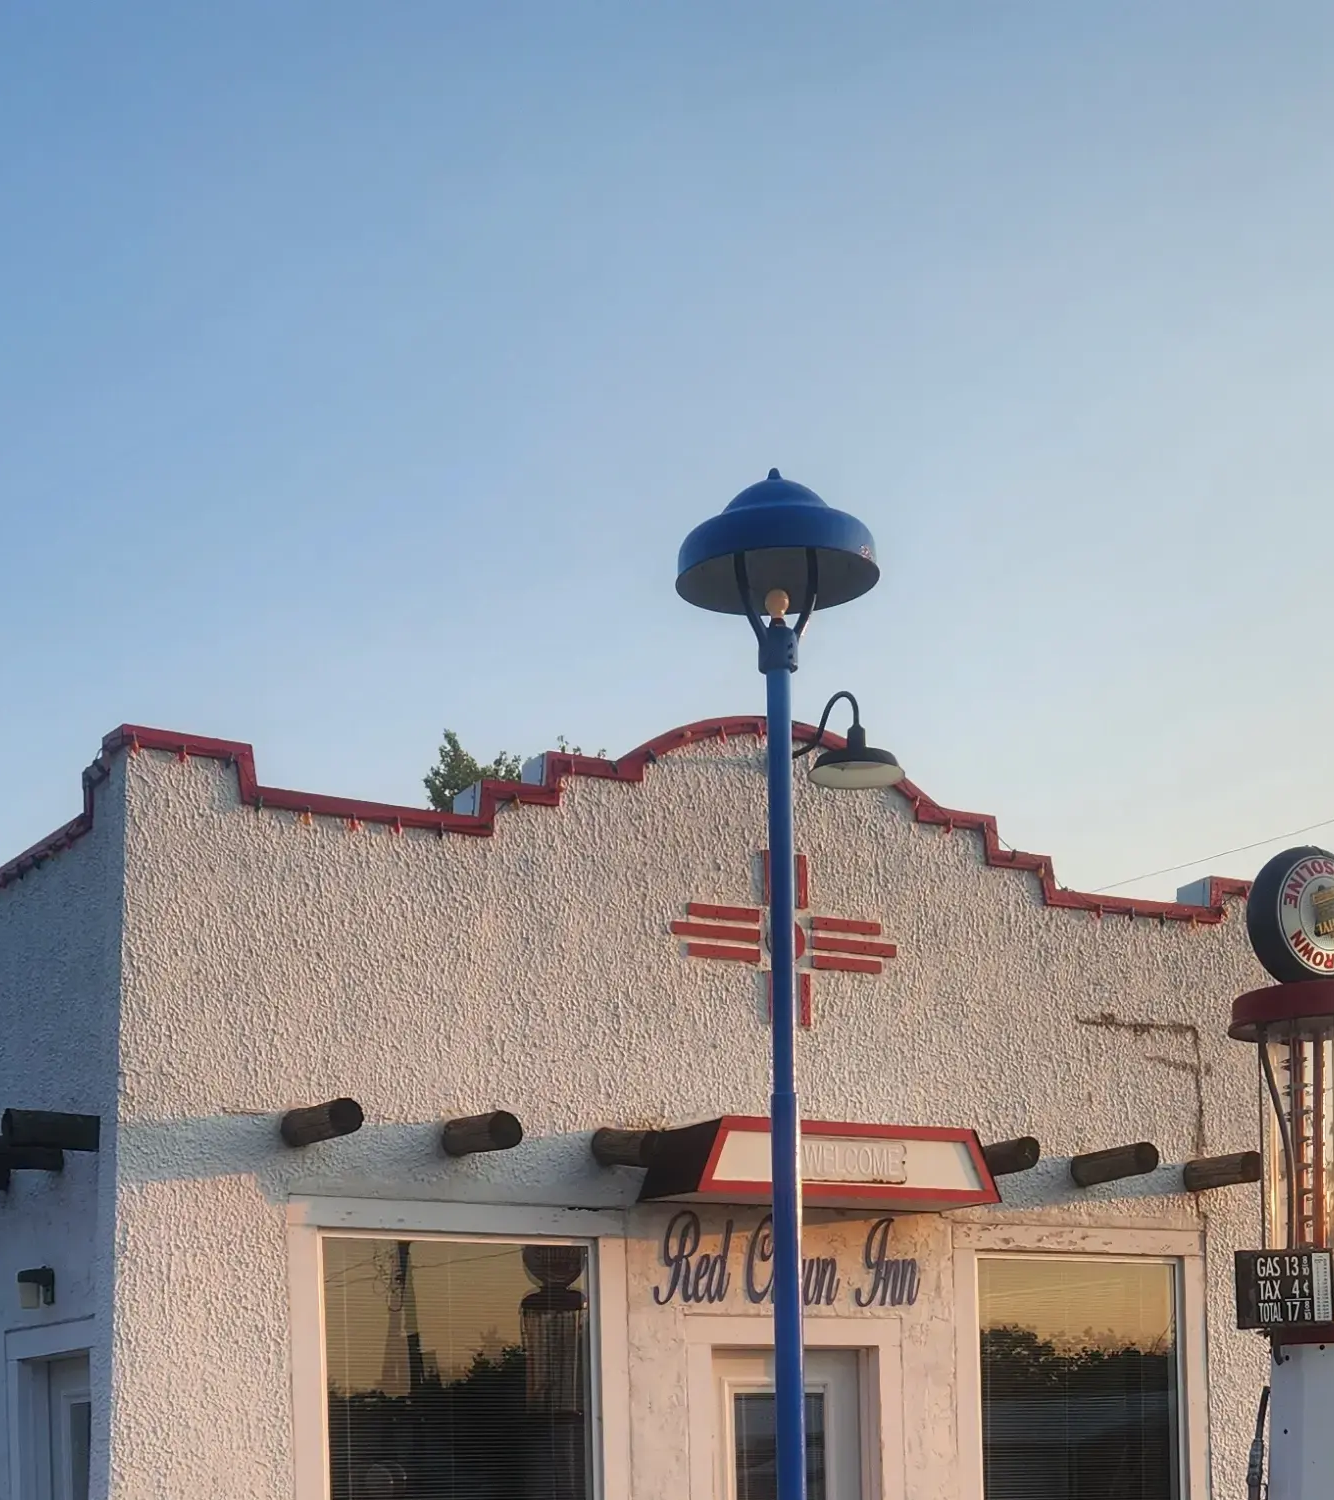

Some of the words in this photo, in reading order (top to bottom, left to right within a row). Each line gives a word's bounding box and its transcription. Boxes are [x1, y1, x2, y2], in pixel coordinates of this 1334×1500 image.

[802, 1144, 900, 1176] WELCOME
[653, 1210, 733, 1305] Red
[746, 1212, 840, 1305] Cwn
[855, 1217, 920, 1307] Inn
[1256, 1257, 1281, 1277] GAS
[1284, 1256, 1299, 1277] 13
[1257, 1280, 1282, 1301] TAX
[1258, 1302, 1283, 1323] TOTAL
[1286, 1301, 1301, 1322] 17
